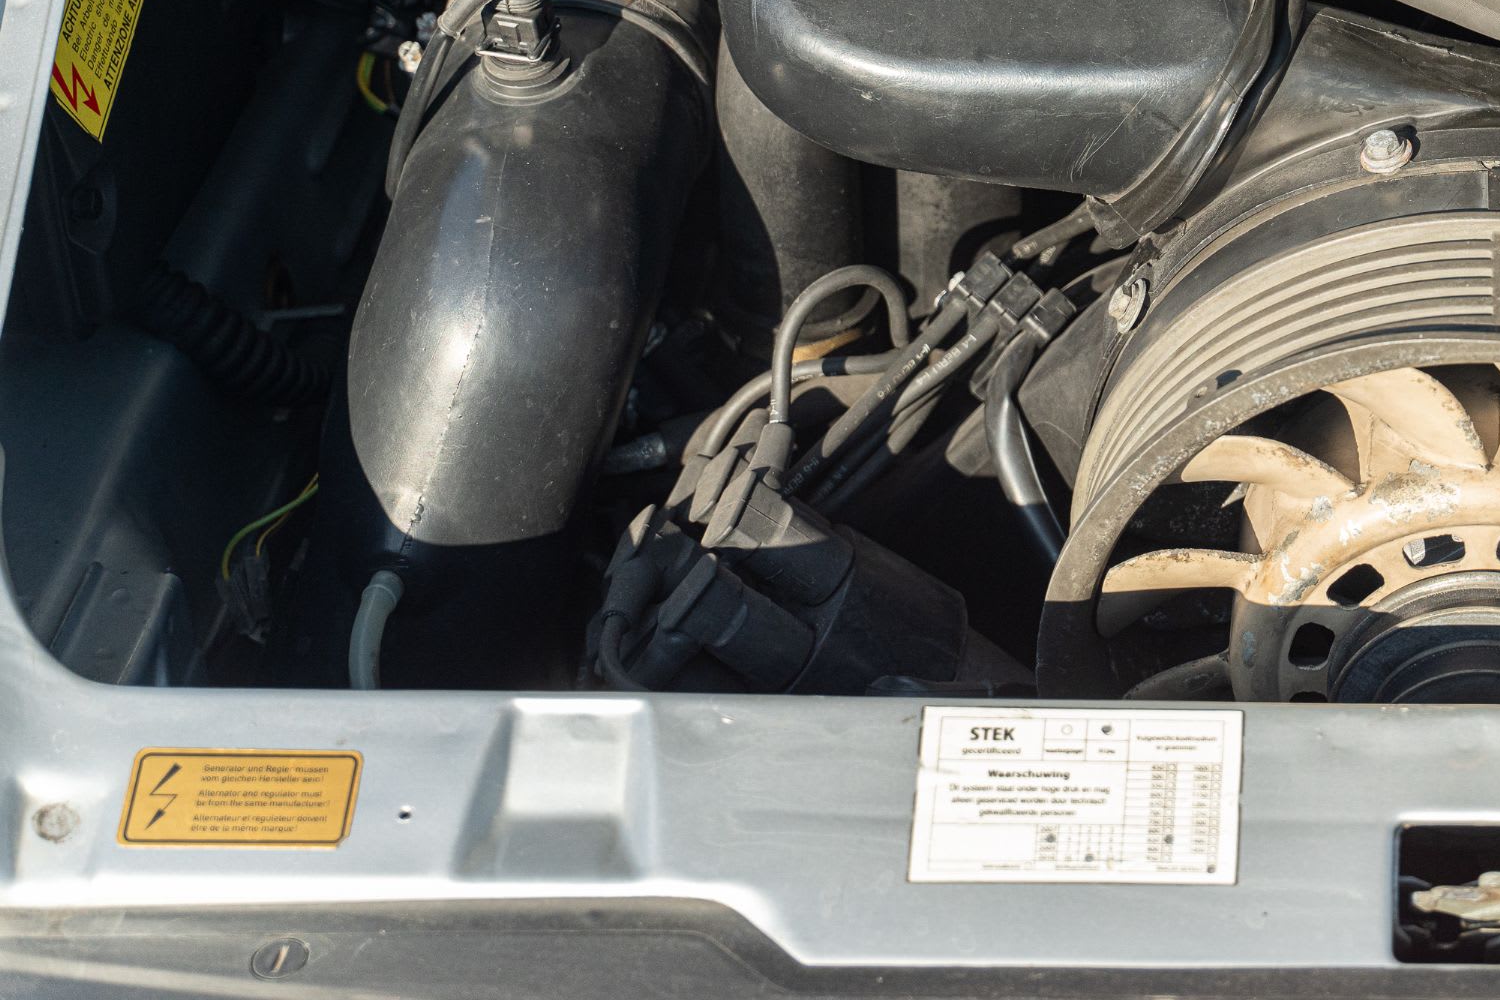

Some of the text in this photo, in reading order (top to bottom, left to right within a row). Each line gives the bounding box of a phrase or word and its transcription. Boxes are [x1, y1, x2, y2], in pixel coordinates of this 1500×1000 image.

[72, 30, 82, 55] Bei
[80, 17, 96, 64] Electric
[87, 29, 104, 75] Danger
[102, 10, 110, 29] de
[94, 14, 118, 81] Effettuando
[103, 7, 132, 91] ATTENZIONE
[969, 726, 1016, 741] STEK
[202, 764, 245, 772] Generator
[987, 769, 1070, 780] Waarschuwing
